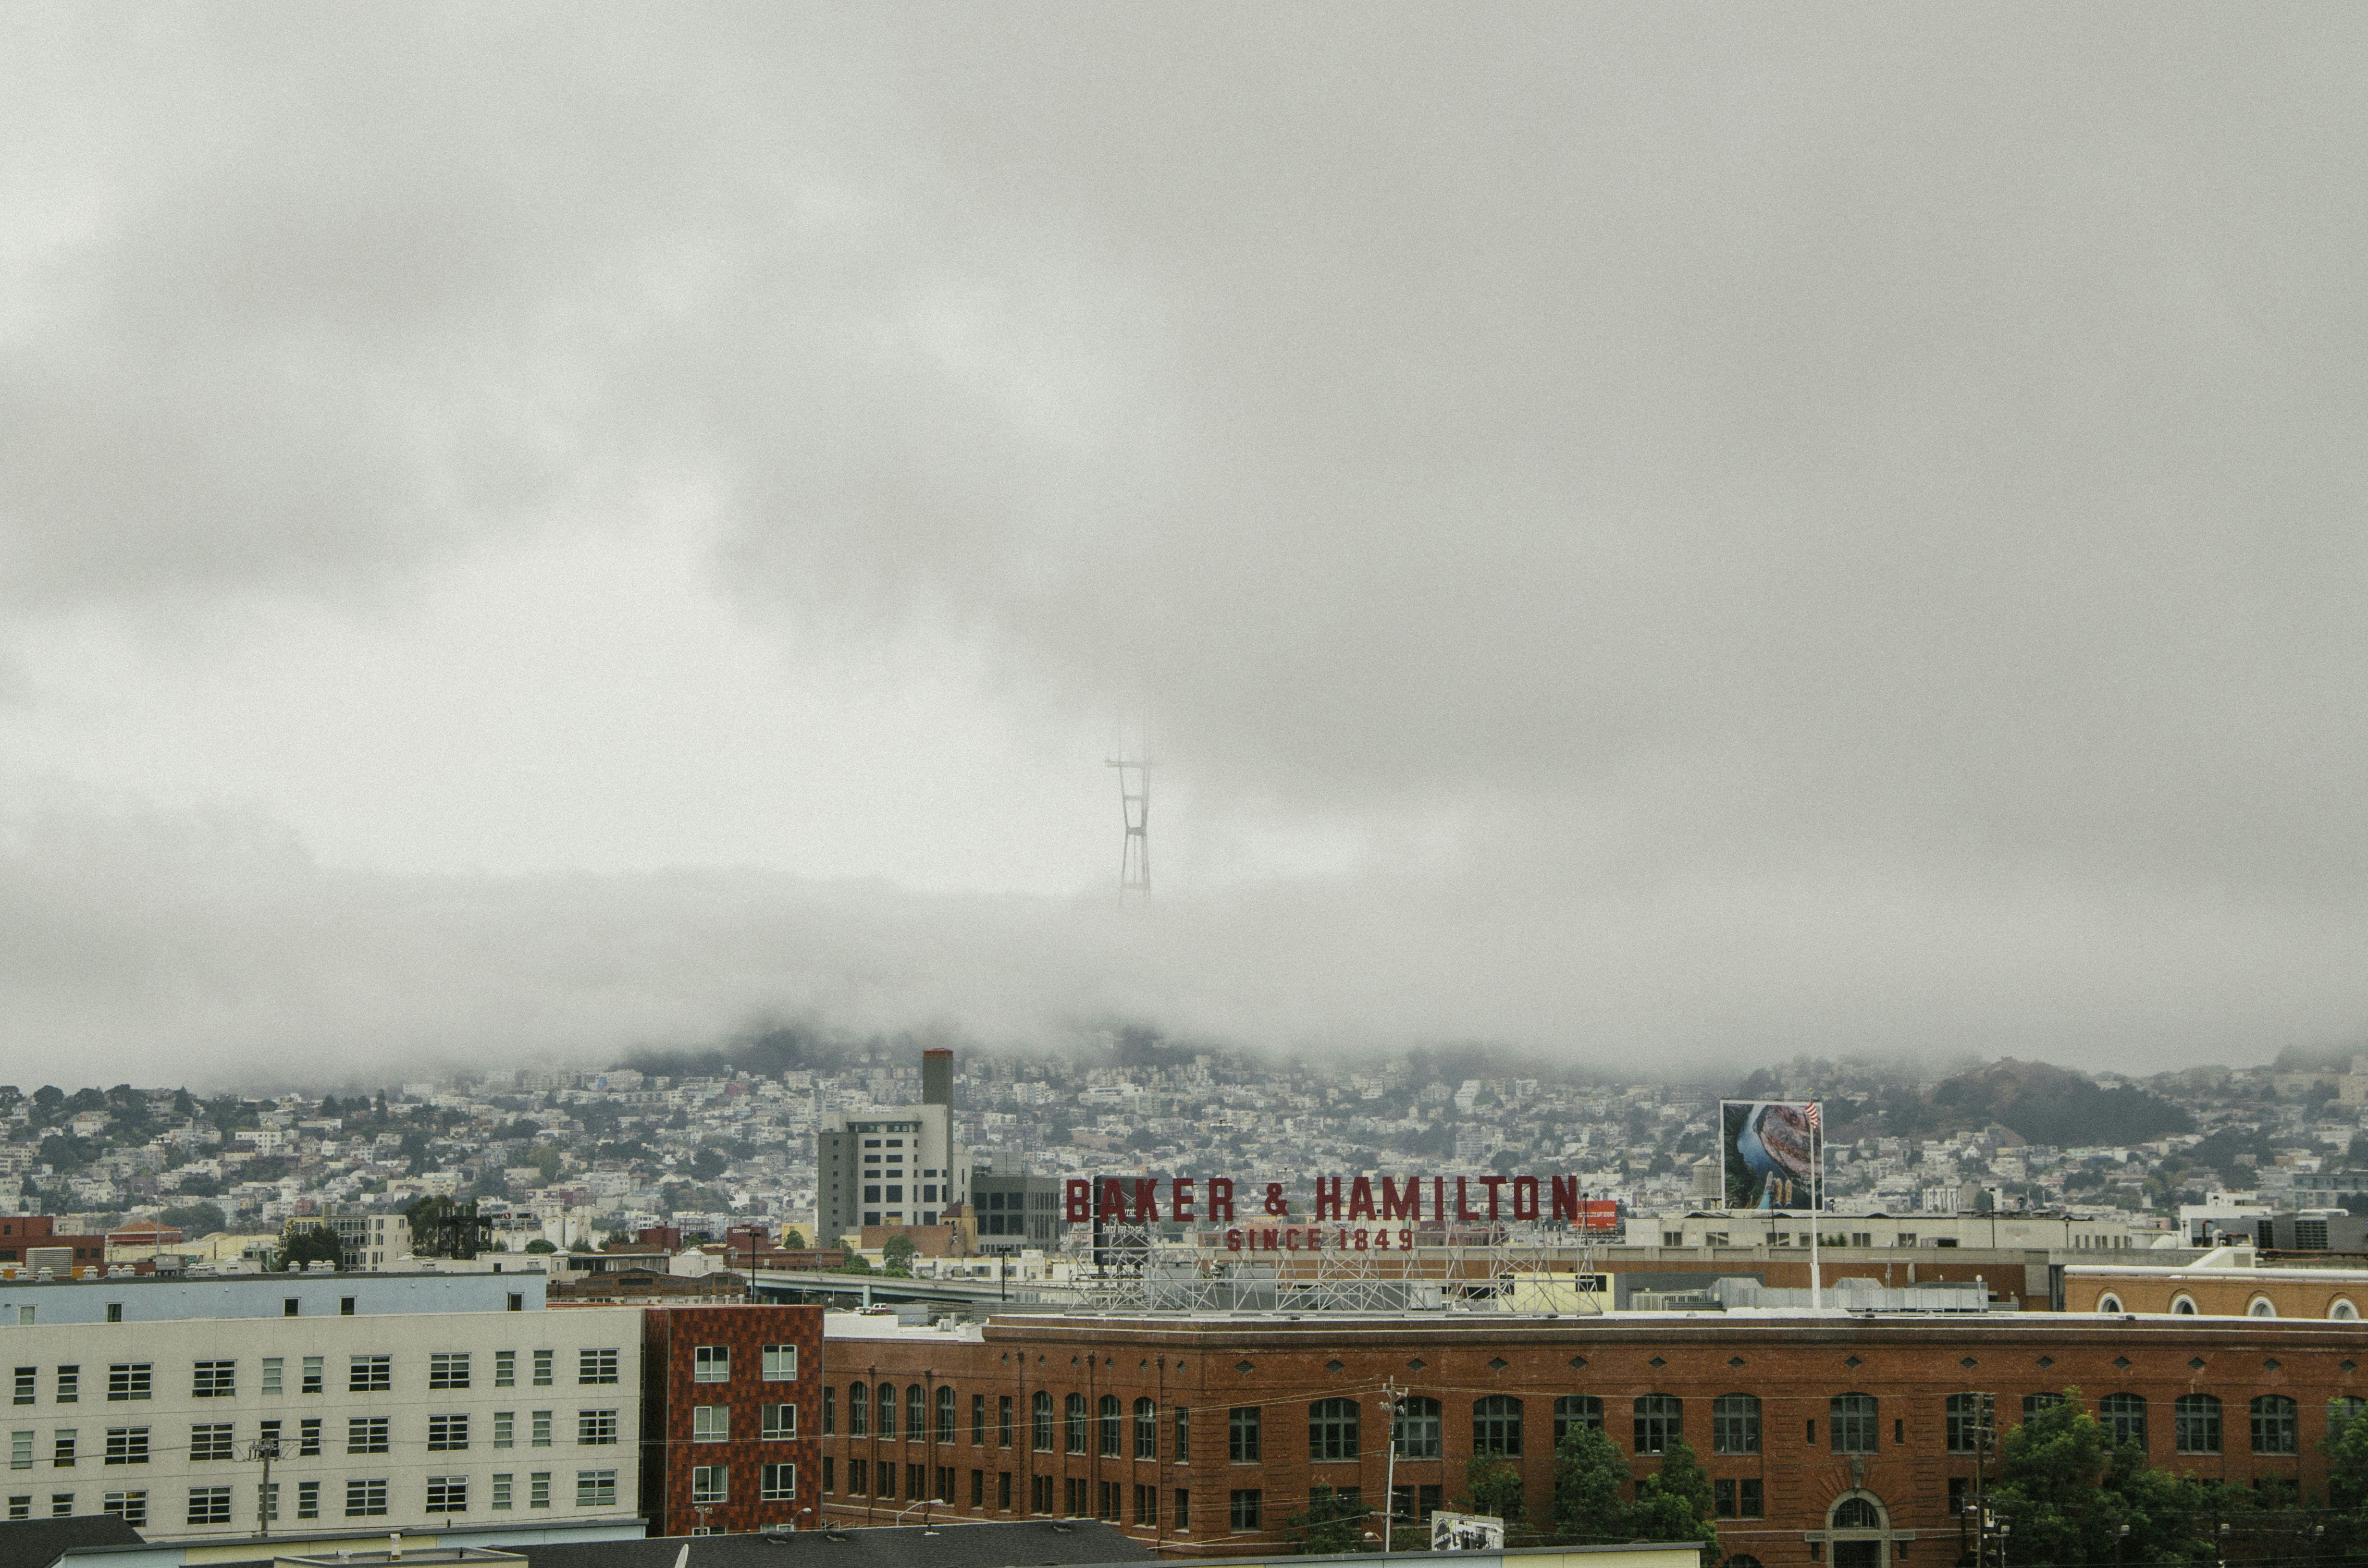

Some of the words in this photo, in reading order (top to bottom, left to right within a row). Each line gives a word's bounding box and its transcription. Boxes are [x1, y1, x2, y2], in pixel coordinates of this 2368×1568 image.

[1067, 1178, 1233, 1222] BAKER
[1264, 1182, 1289, 1216] &
[1316, 1176, 1578, 1221] HAMILTON
[1227, 1228, 1322, 1251] SINCE
[1340, 1228, 1413, 1251] 1849
